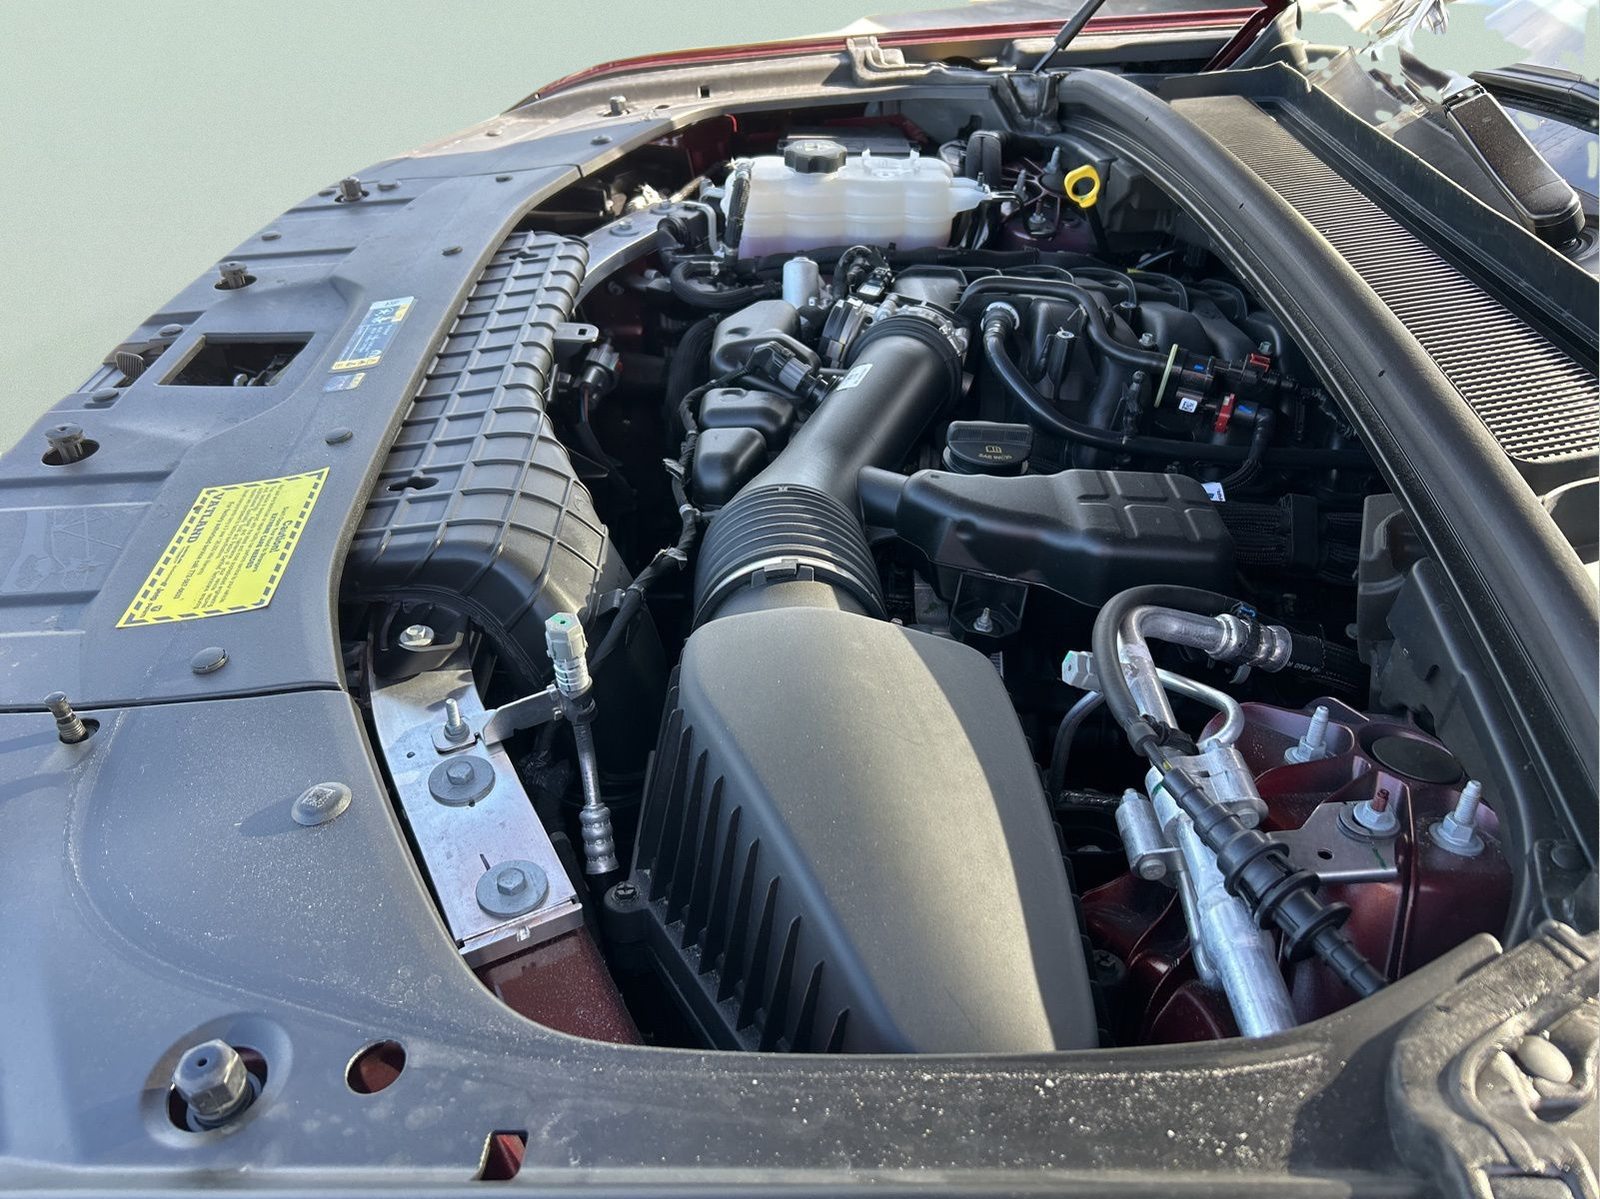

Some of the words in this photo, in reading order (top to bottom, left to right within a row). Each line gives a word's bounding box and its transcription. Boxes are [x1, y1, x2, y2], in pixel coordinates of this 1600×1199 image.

[185, 492, 226, 544] VATLAND
[262, 512, 279, 535] EXTREME
[255, 534, 268, 548] CARE
[268, 519, 294, 554] Caution!
[244, 548, 261, 569] NEEDED
